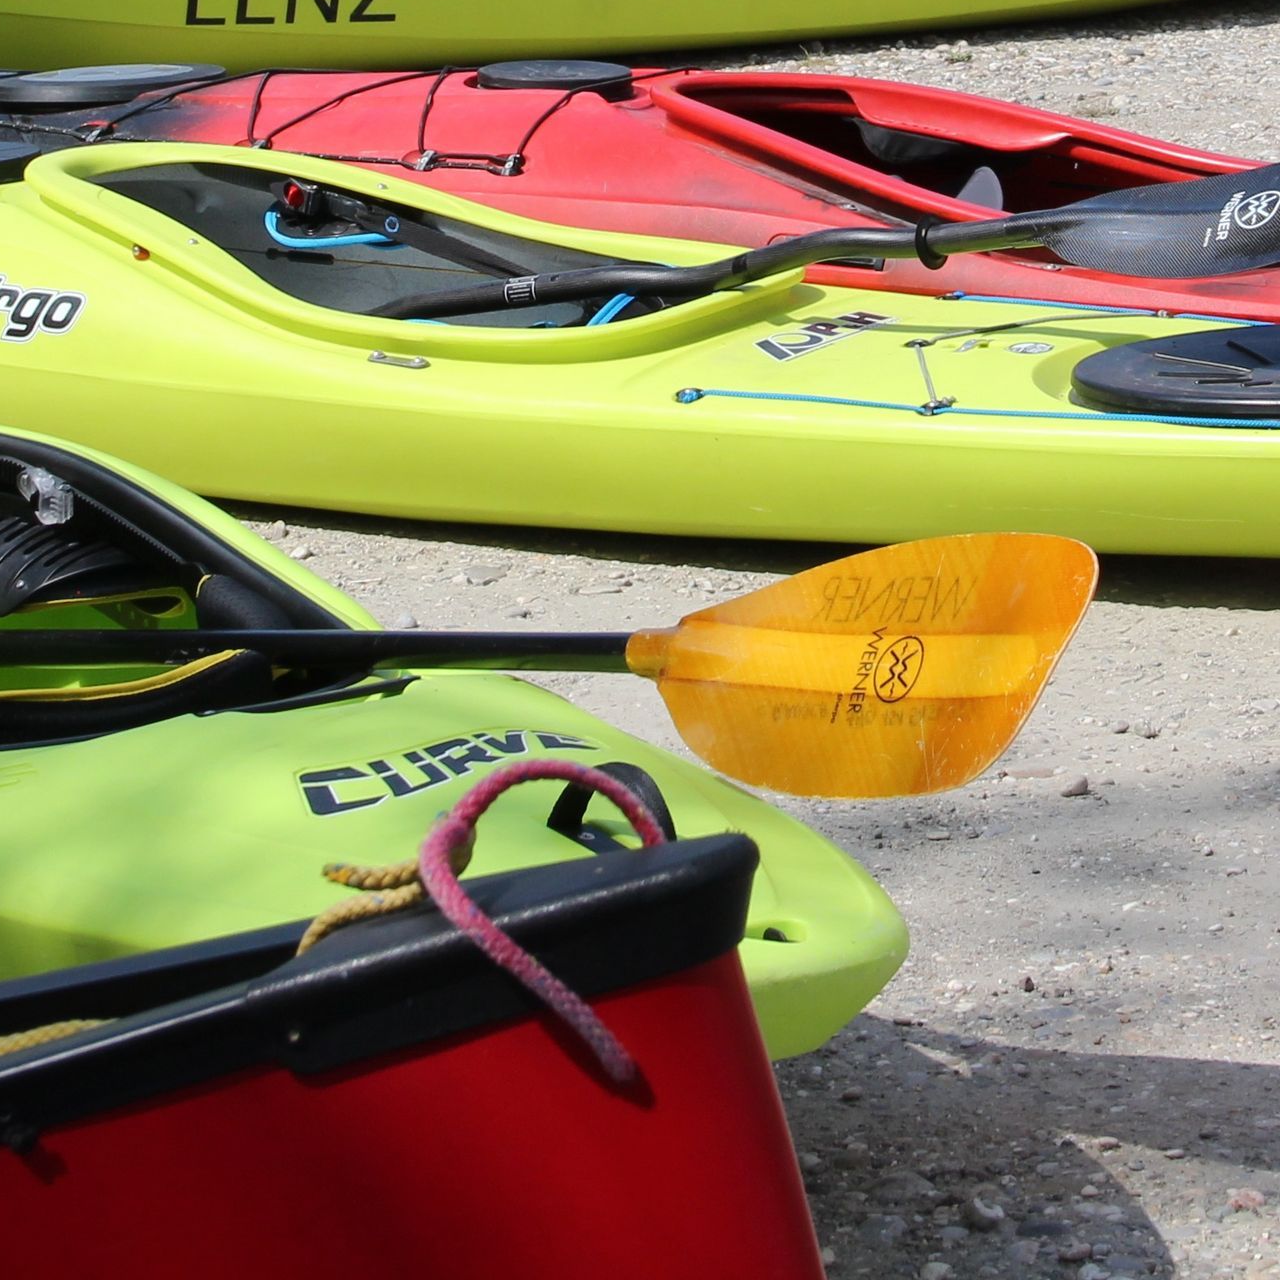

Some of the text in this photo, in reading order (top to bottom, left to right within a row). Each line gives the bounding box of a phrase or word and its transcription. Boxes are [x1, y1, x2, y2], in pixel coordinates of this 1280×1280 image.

[1215, 190, 1247, 241] WERNER
[846, 625, 888, 714] WERNER
[298, 729, 602, 816] CURVE
